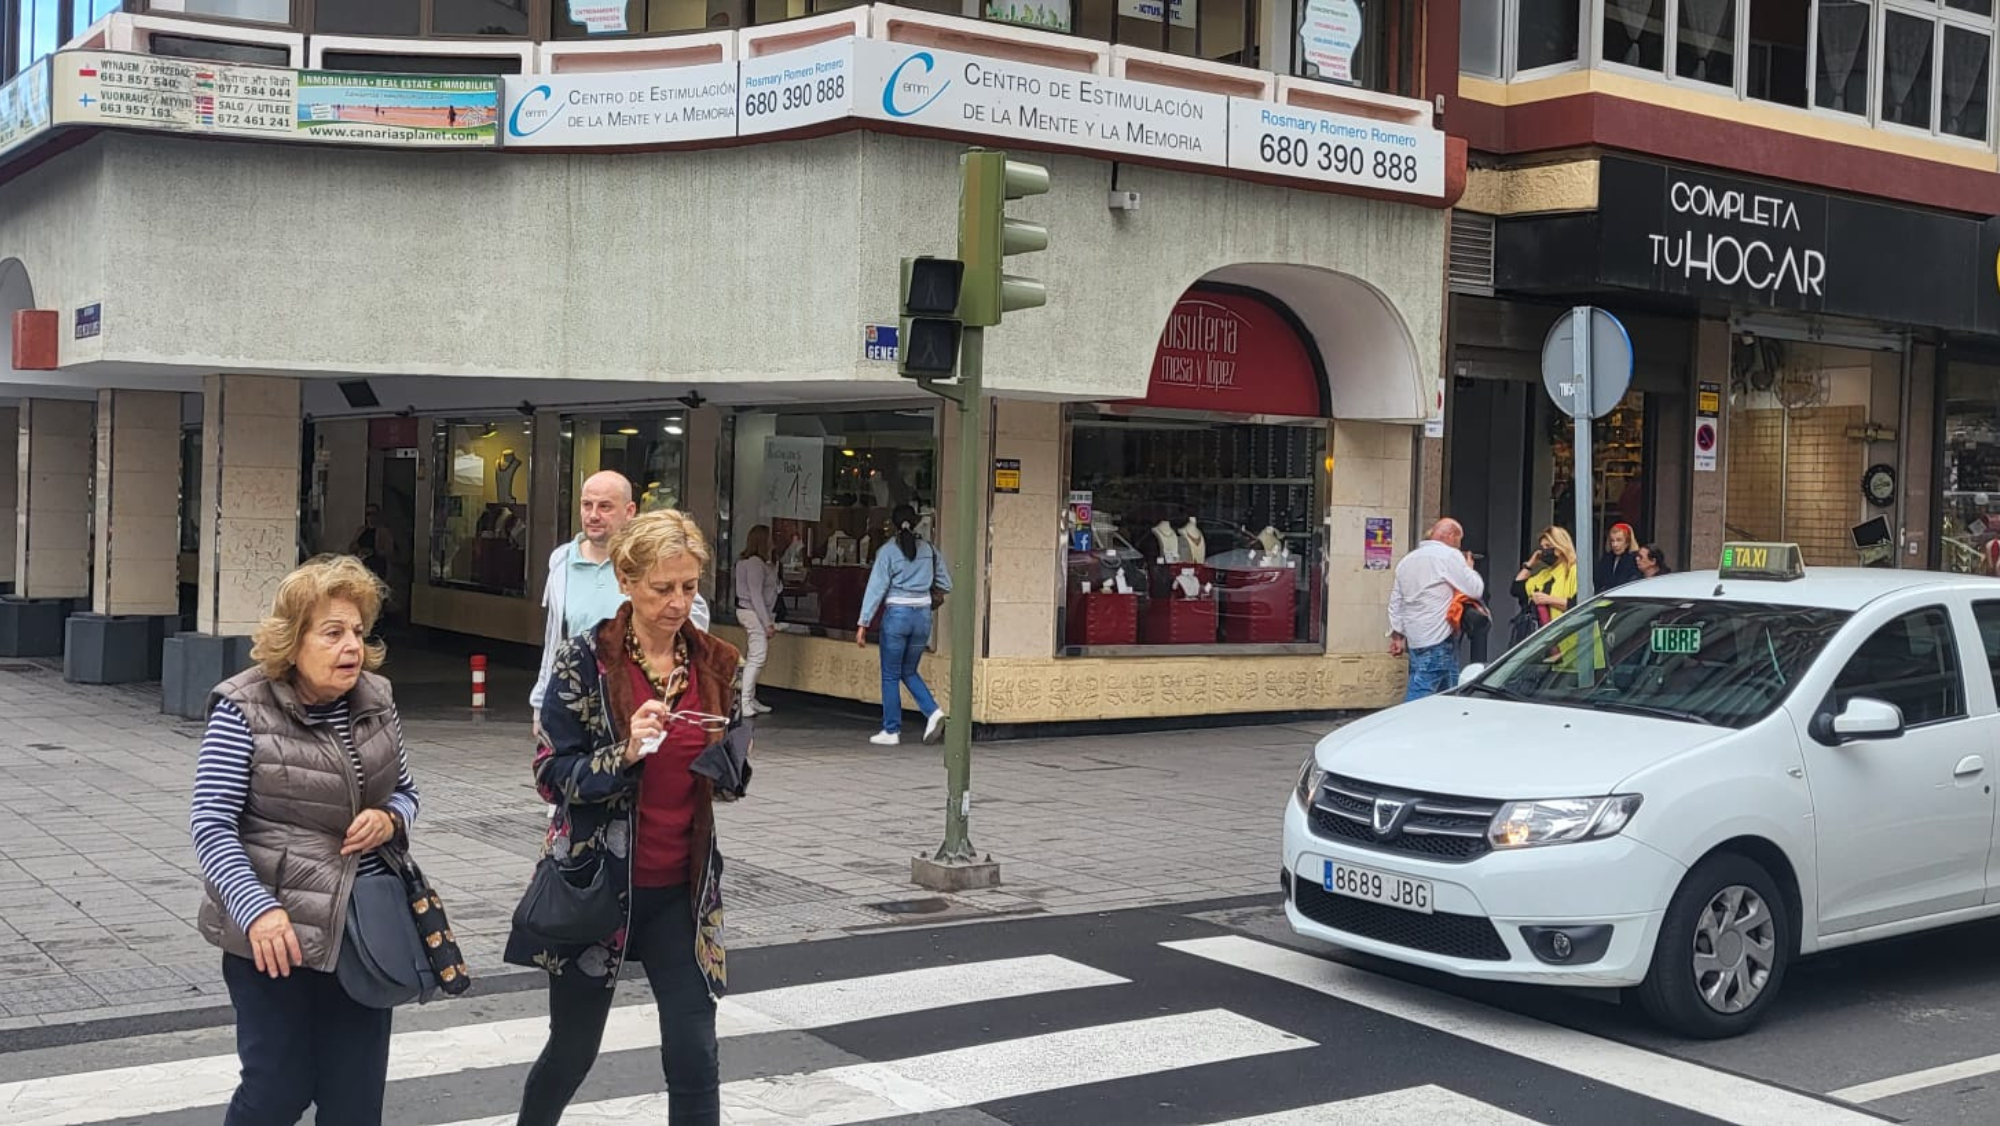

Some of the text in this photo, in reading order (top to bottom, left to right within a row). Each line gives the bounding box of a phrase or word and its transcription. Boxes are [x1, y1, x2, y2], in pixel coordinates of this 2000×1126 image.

[100, 59, 140, 73] WYNAJEM
[745, 58, 844, 89] Rosmary Romero Romero
[100, 73, 123, 83] 663
[127, 75, 149, 86] 857
[243, 85, 264, 96] 584
[269, 87, 292, 98] 044
[303, 74, 495, 91] INMOBILIARIA REAL ESTATE IMMOBILIEN
[963, 62, 1042, 95] CENTRO
[1079, 80, 1204, 120] ESTIMULACIÓN
[569, 90, 625, 106] CENTRO
[650, 81, 736, 102] ESTIMULACIÓN
[745, 74, 845, 117] 680 390 888
[100, 103, 172, 118] 663 957 163
[218, 101, 244, 112] SALG
[257, 103, 292, 115] UTLEIE
[218, 111, 291, 128] 672 461 241
[607, 110, 650, 127] MENTE
[682, 106, 736, 122] MEMORIA
[308, 126, 480, 143] www.canariasplanet.com
[1018, 104, 1079, 135] MENTE
[1126, 121, 1204, 152] MEMORIA
[1260, 109, 1418, 148] Rosmary Romero Romero
[1260, 133, 1419, 184] 680 390 888
[1671, 181, 1801, 232] COMPLETA
[1649, 230, 1826, 297] TU HOGAR
[1161, 355, 1194, 383] mesa
[1735, 547, 1768, 568] TAXI
[1654, 627, 1699, 651] LIBRE
[1336, 866, 1428, 908] 8689 JBG
